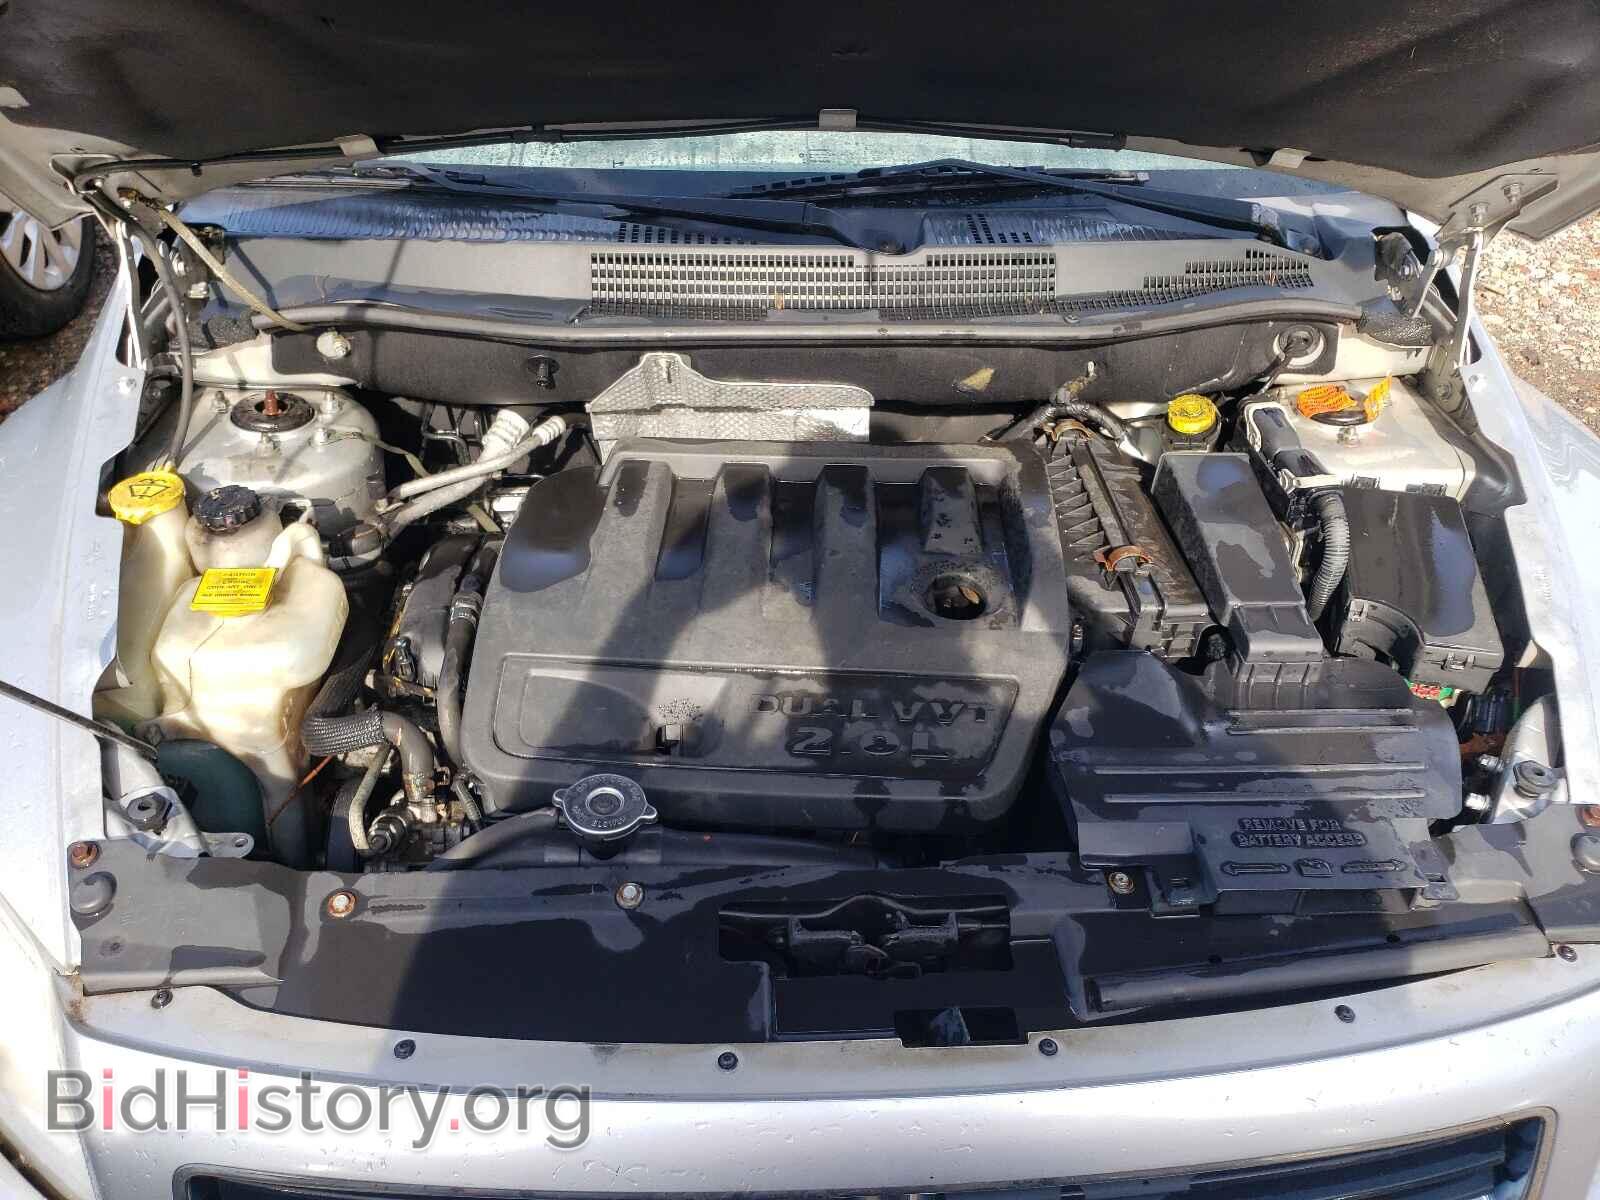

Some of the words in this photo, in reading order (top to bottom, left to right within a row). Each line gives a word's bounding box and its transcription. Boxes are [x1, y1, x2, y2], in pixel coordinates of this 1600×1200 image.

[751, 693, 880, 719] DUAL
[891, 700, 995, 725] VVT
[788, 726, 951, 761] 2.0L
[1243, 817, 1305, 831] REMOVE
[1308, 818, 1341, 832] FOR
[1238, 832, 1301, 847] BATTERY
[1305, 832, 1366, 847] ACCESS
